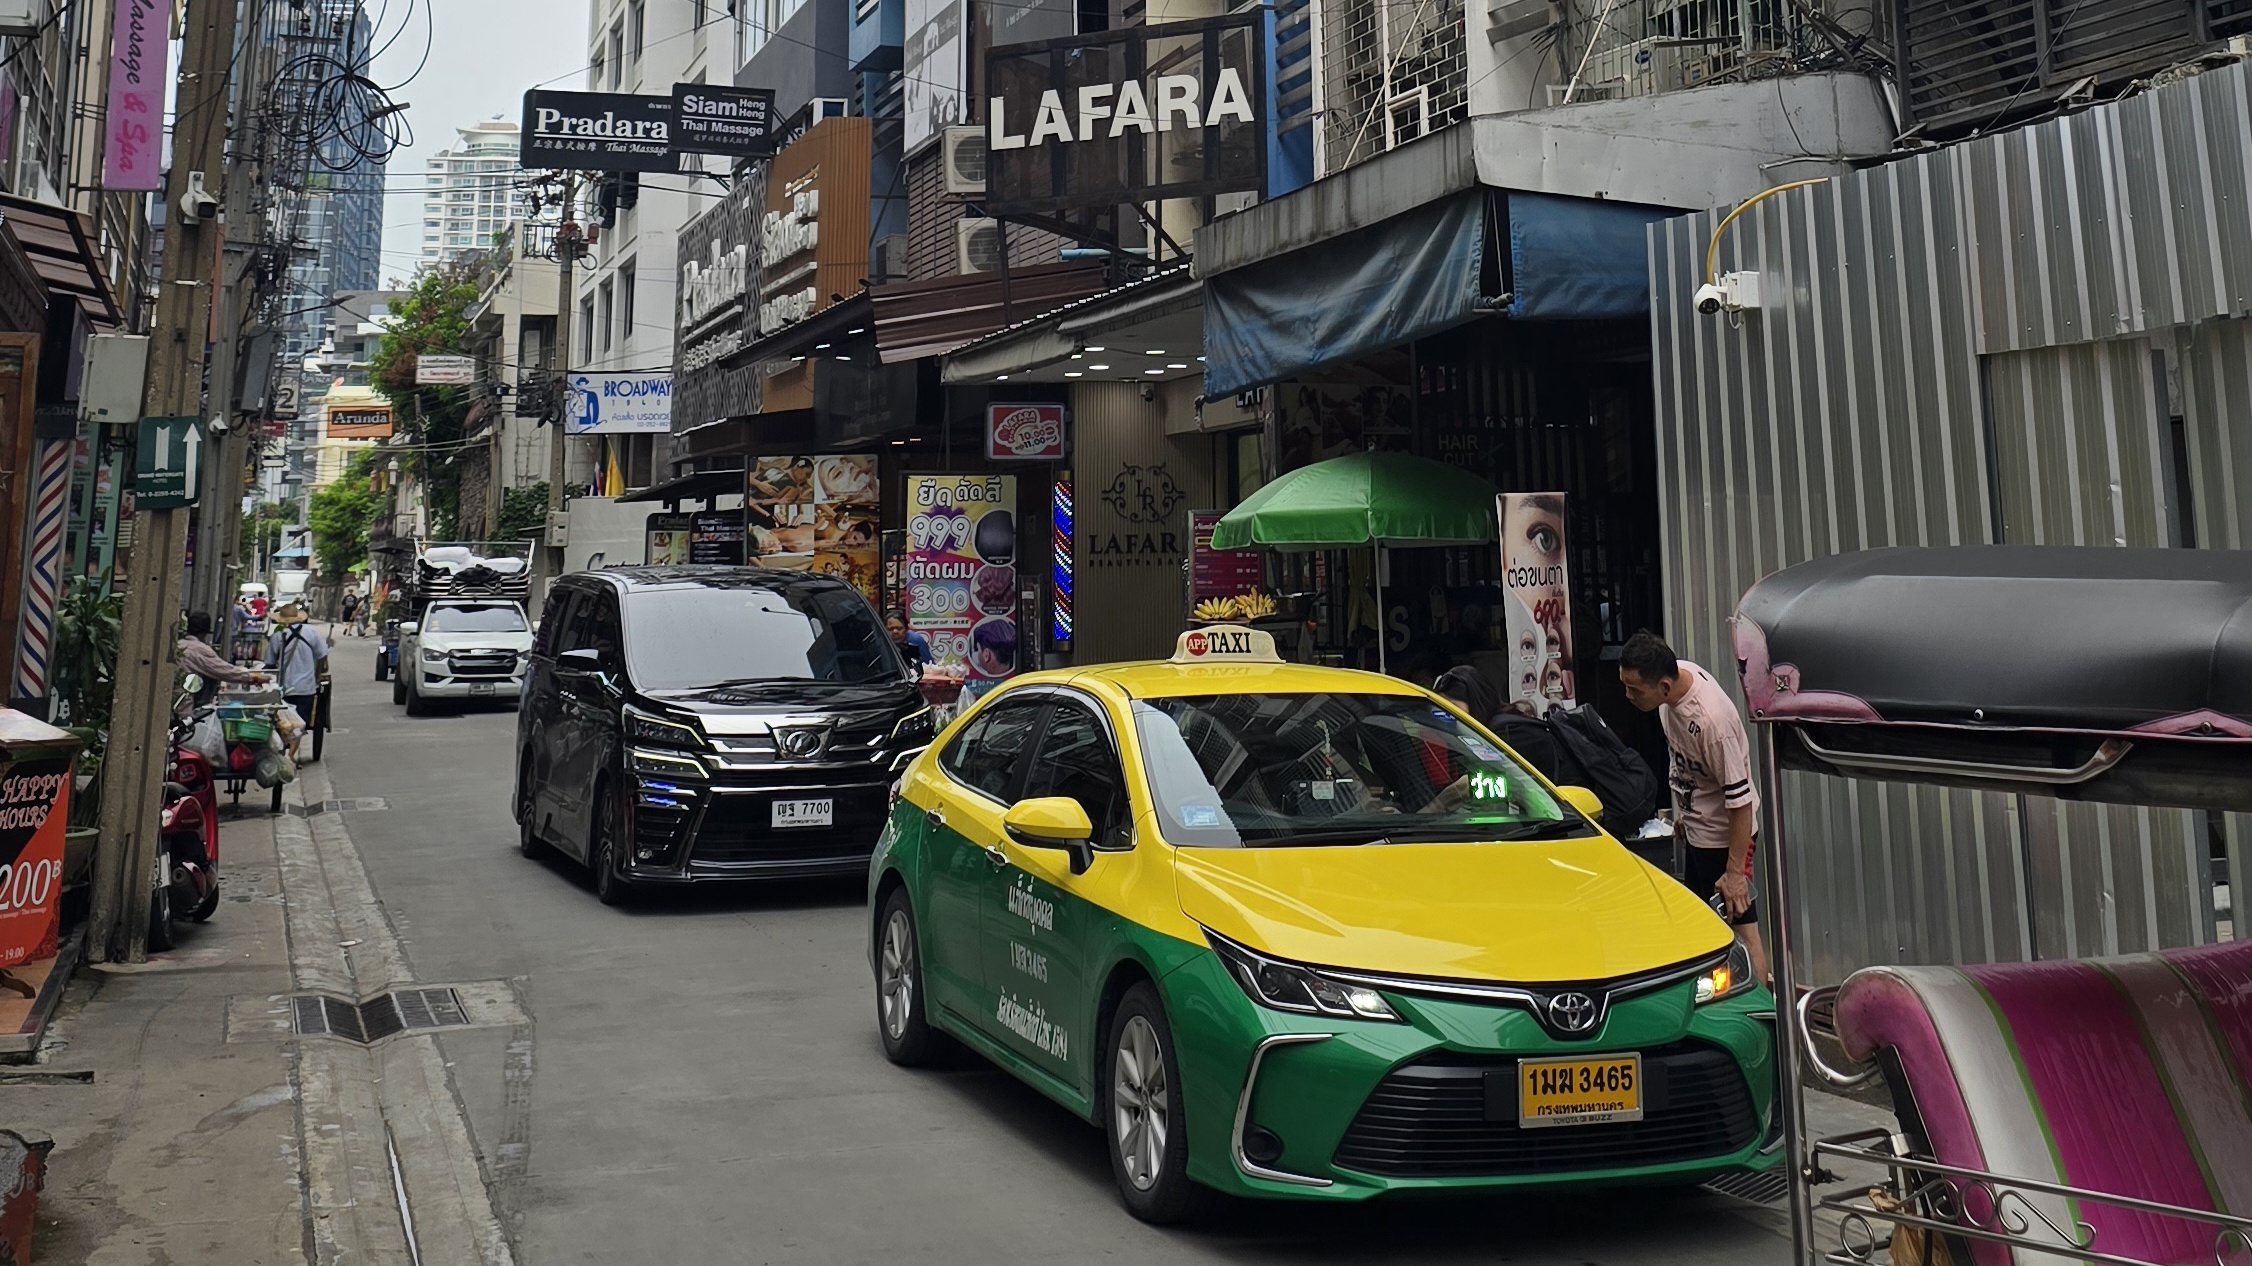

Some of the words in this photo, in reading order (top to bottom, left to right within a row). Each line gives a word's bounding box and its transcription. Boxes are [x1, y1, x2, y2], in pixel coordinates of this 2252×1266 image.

[123, 93, 147, 113] &
[682, 95, 737, 116] Siam
[739, 98, 766, 110] Heng
[738, 110, 765, 119] Heng
[990, 67, 1254, 150] LAFARA
[534, 107, 668, 139] Pradara
[681, 119, 707, 132] Thai
[710, 122, 764, 137] Massage
[114, 119, 147, 172] Spa
[604, 142, 627, 152] Thai
[604, 380, 672, 397] BROADWAY
[1438, 434, 1479, 450] HAIR
[1443, 452, 1475, 466] CUT
[917, 478, 952, 507] ยืด
[955, 478, 983, 502] ดัด
[985, 475, 1002, 503] สี
[909, 514, 972, 550] 999
[1089, 532, 1180, 555] LAFAR
[909, 555, 975, 580] ตัดผม
[1507, 558, 1563, 589] ต่อขนตา
[909, 584, 970, 615] 300
[1187, 638, 1208, 651] APP
[1207, 632, 1252, 654] TAXI
[0, 772, 69, 804] HAPPY
[1470, 769, 1506, 800] ว่าง
[0, 804, 49, 829] HOURS
[802, 801, 830, 815] 7700
[1579, 1064, 1633, 1094] 3465
[1537, 1101, 1625, 1116] กรงเทพมหานคร
[1553, 1117, 1579, 1125] TOYOTA
[1588, 1114, 1613, 1122] BUZZ
